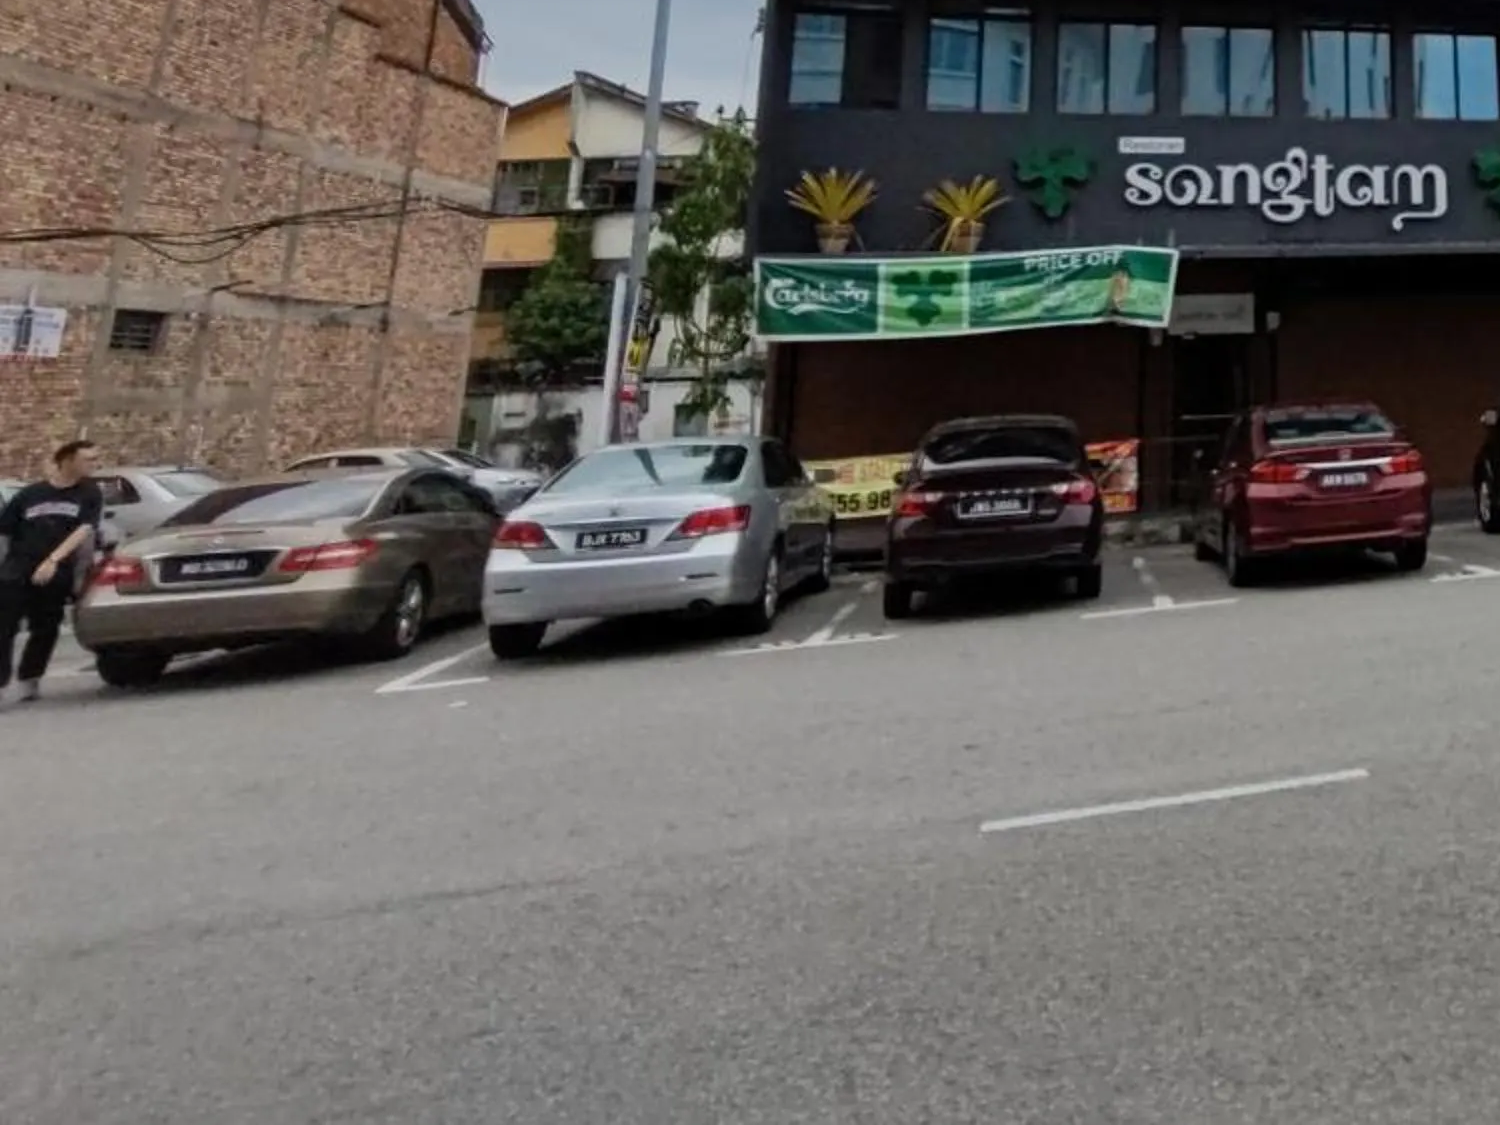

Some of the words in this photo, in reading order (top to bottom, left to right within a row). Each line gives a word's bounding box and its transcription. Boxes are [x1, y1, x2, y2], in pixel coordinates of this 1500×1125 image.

[1023, 253, 1082, 272] PRICE
[1086, 249, 1124, 266] OFF
[866, 489, 892, 511] 98
